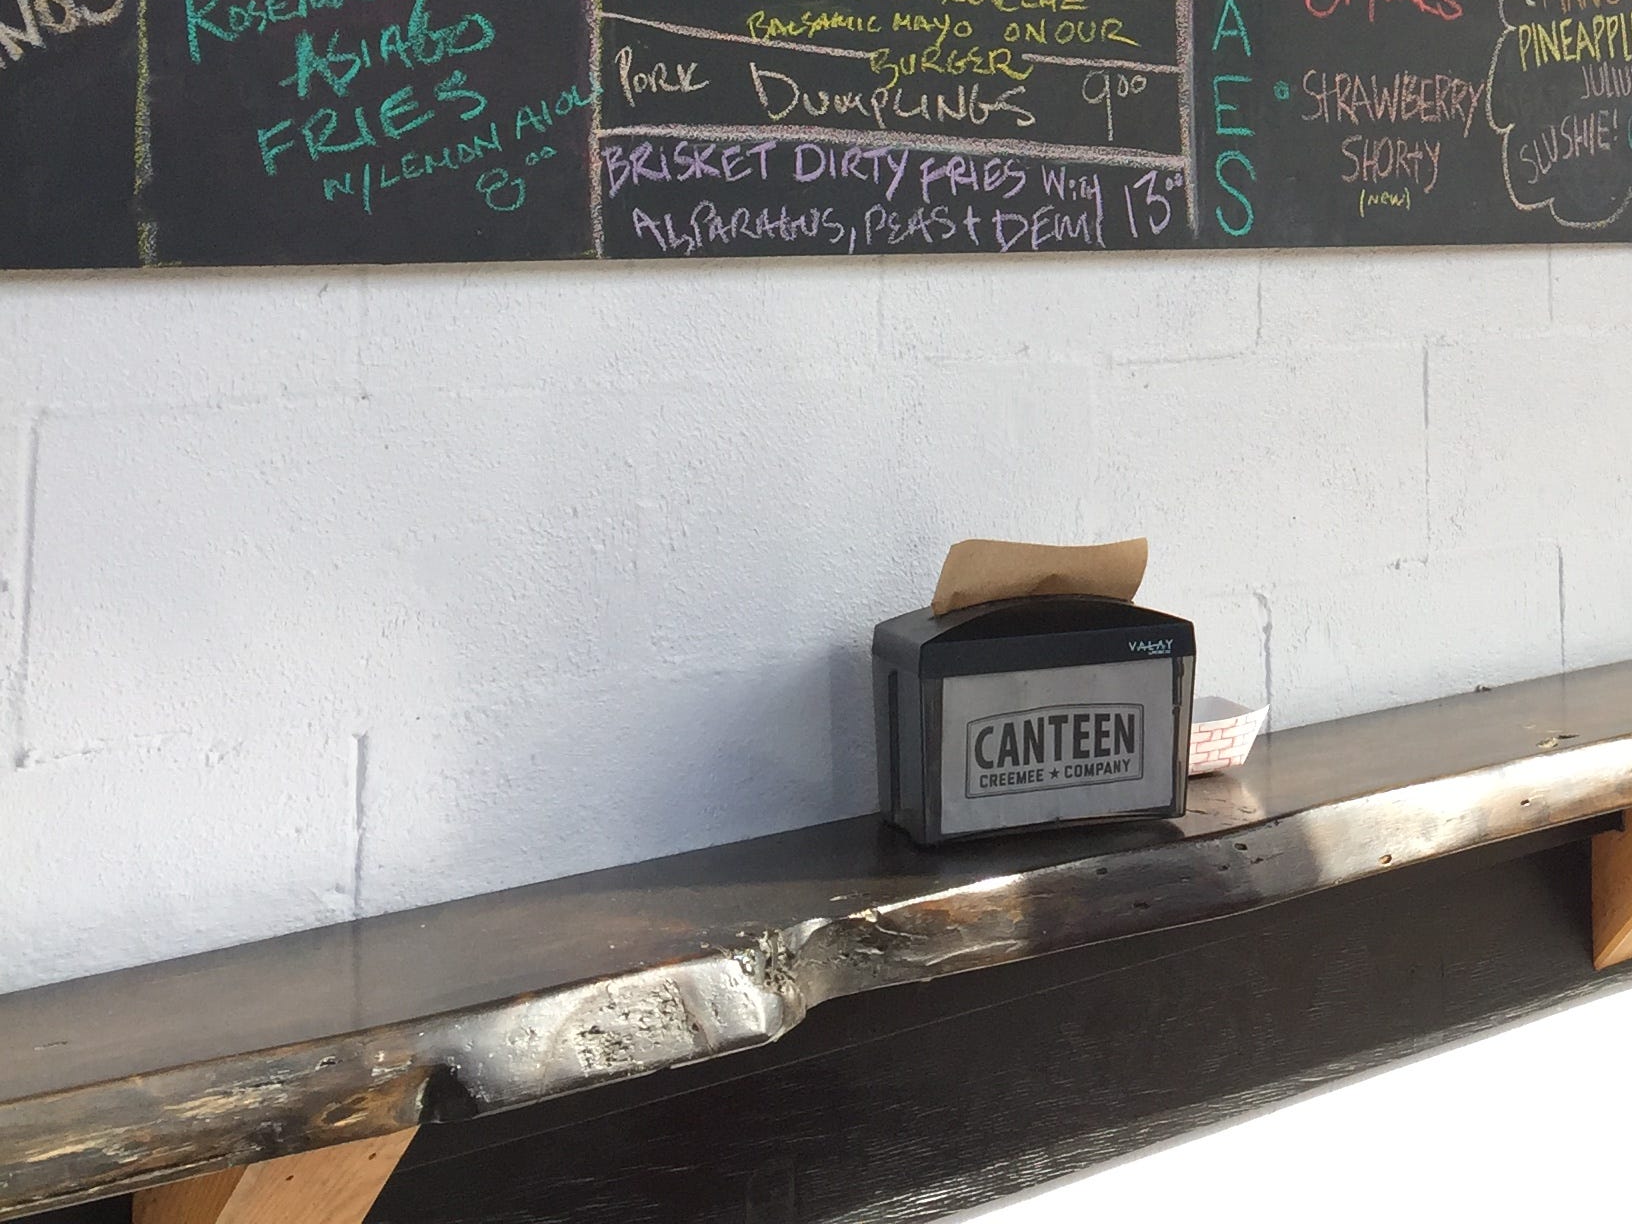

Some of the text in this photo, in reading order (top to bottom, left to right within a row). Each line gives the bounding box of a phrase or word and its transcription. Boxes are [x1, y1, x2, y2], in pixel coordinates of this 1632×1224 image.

[893, 13, 973, 49] MAYO
[615, 46, 710, 107] PORK
[870, 46, 1034, 91] BURGER
[257, 69, 487, 176] FRIES
[1302, 70, 1485, 138] STRAWBERRY
[601, 141, 778, 199] BRISKET
[793, 143, 909, 202] DIRTY
[919, 156, 1026, 204] FRIES
[975, 713, 1135, 769] CANTEEN
[979, 759, 1131, 788] CREEMEE COMPANY
